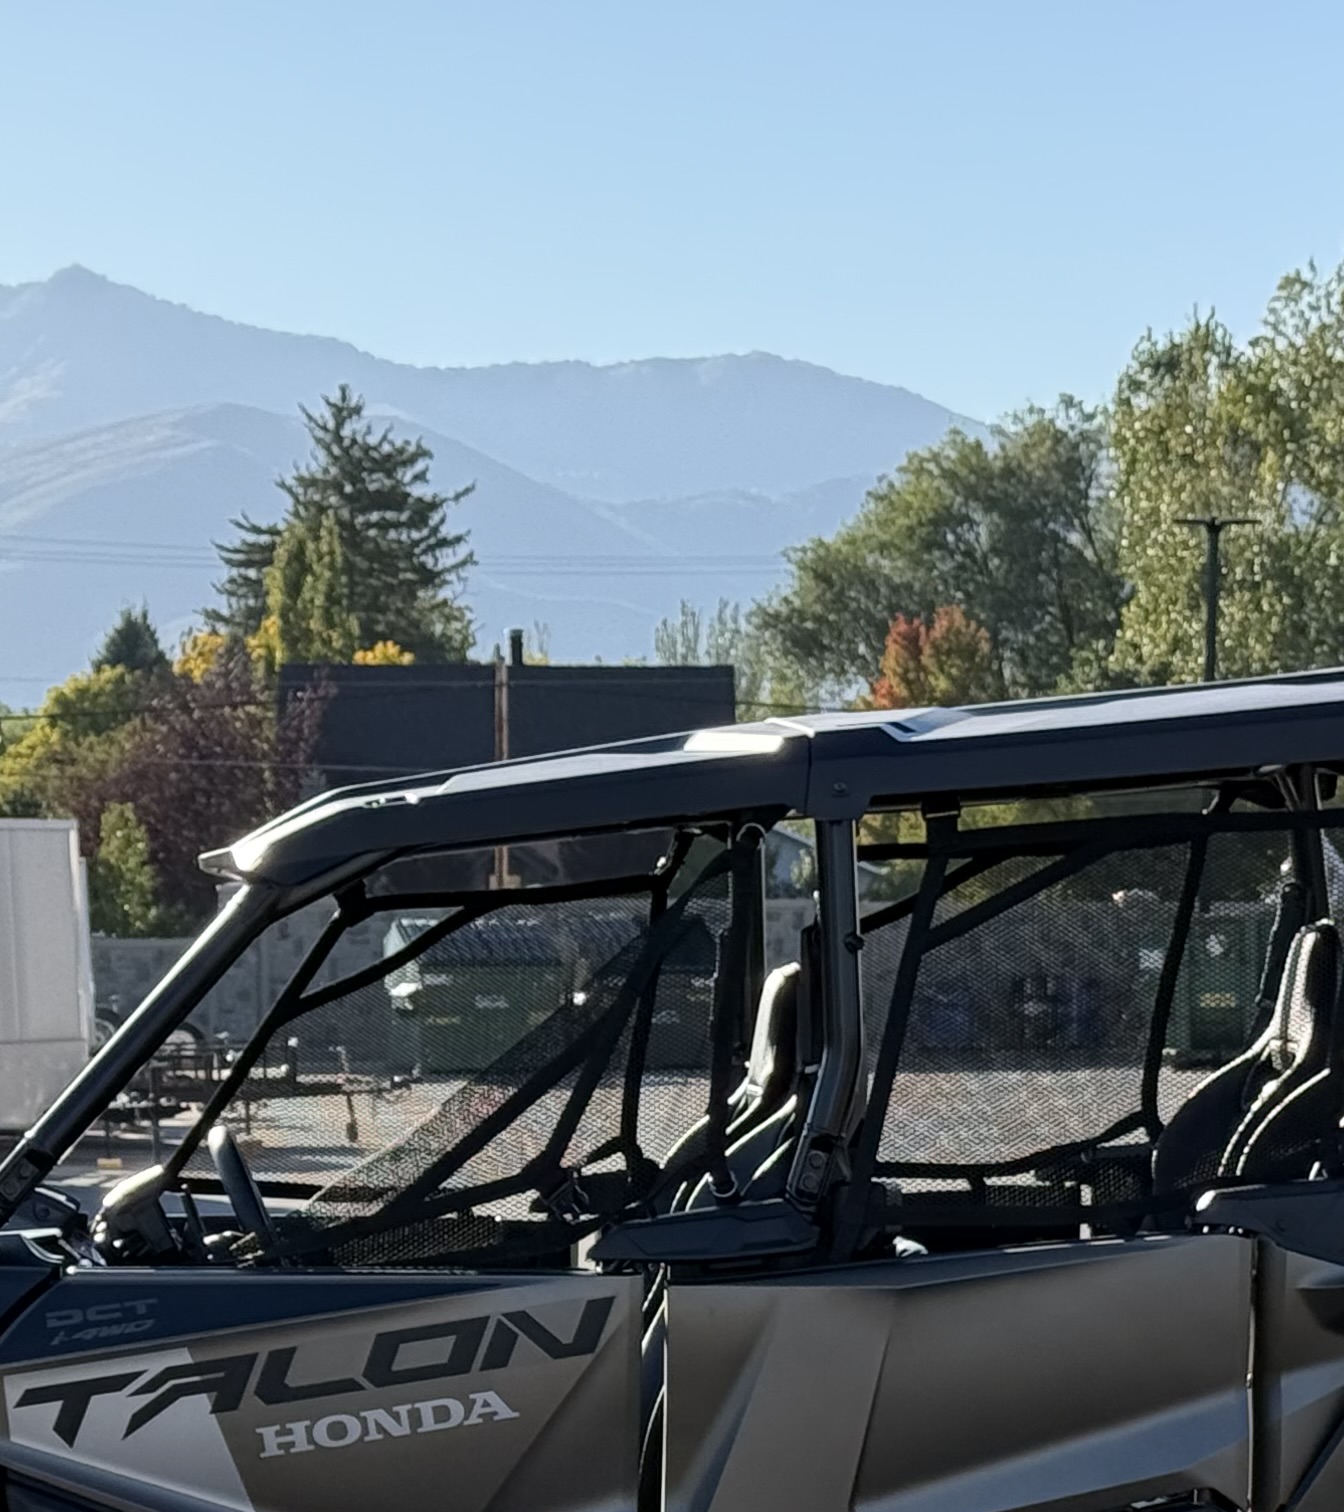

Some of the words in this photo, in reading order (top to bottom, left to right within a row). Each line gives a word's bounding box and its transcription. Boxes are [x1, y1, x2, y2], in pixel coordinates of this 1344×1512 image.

[45, 1298, 158, 1328] DCT
[13, 1295, 617, 1449] TALON
[255, 1390, 521, 1459] HONDA
